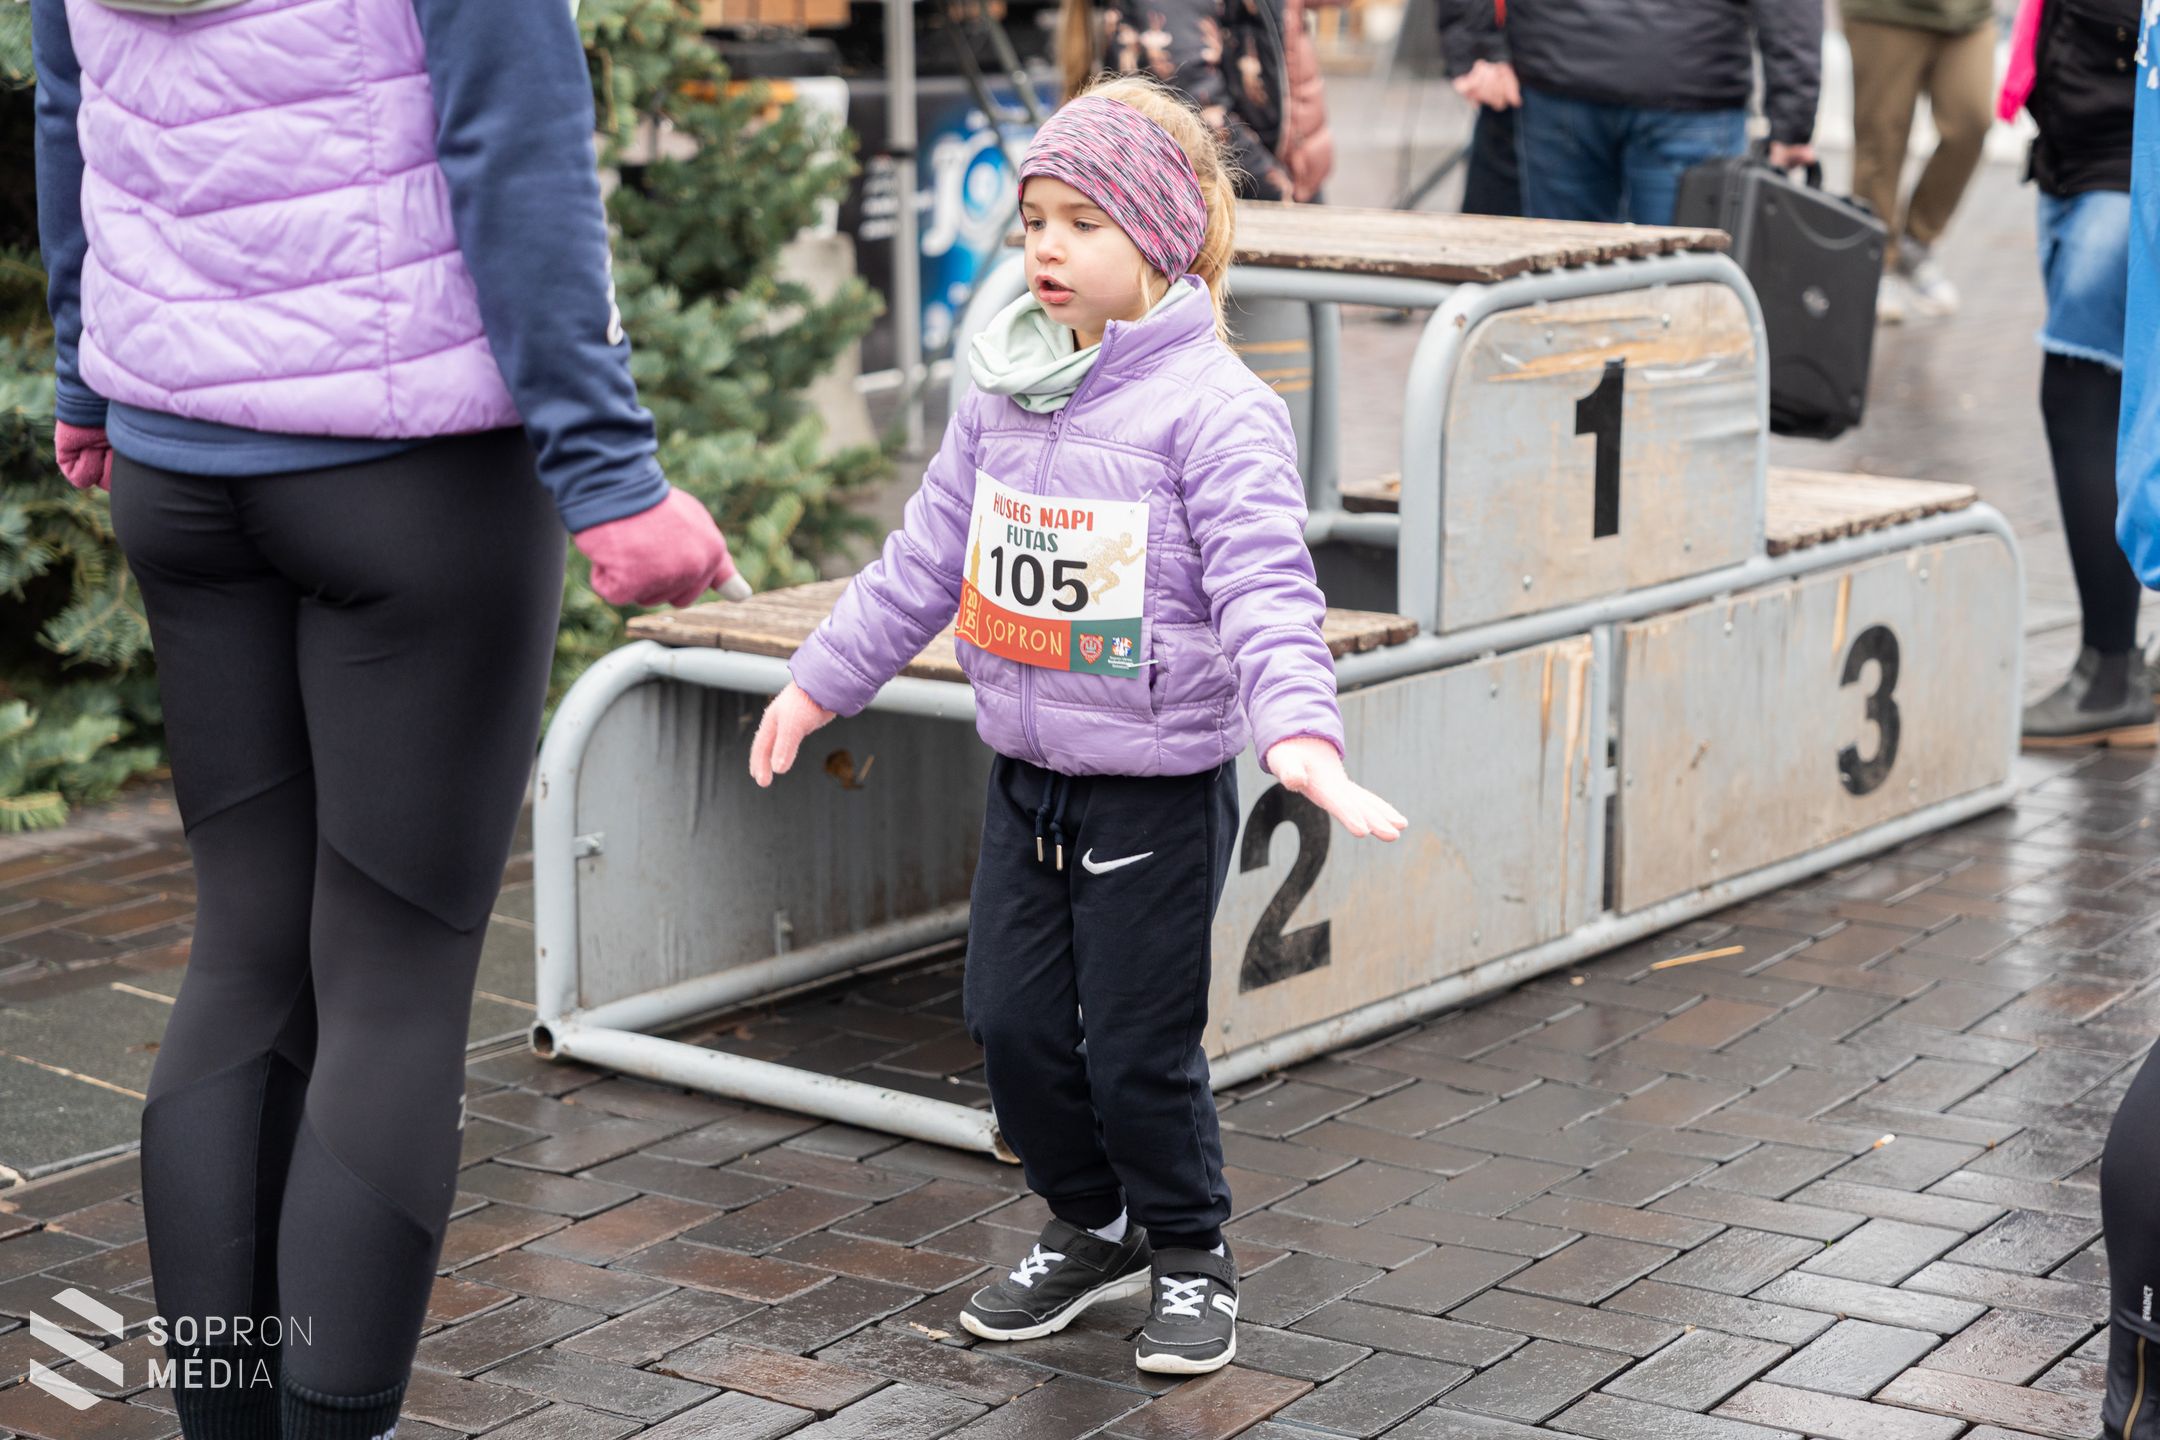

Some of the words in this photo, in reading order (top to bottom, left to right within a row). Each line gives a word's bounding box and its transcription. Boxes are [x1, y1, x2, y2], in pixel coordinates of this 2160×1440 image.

[1575, 357, 1626, 539] 1
[1040, 507, 1093, 531] NAPI
[976, 613, 1062, 656] SOPRON
[991, 545, 1089, 613] 105
[1838, 625, 1900, 796] 3
[1239, 782, 1331, 995] 2
